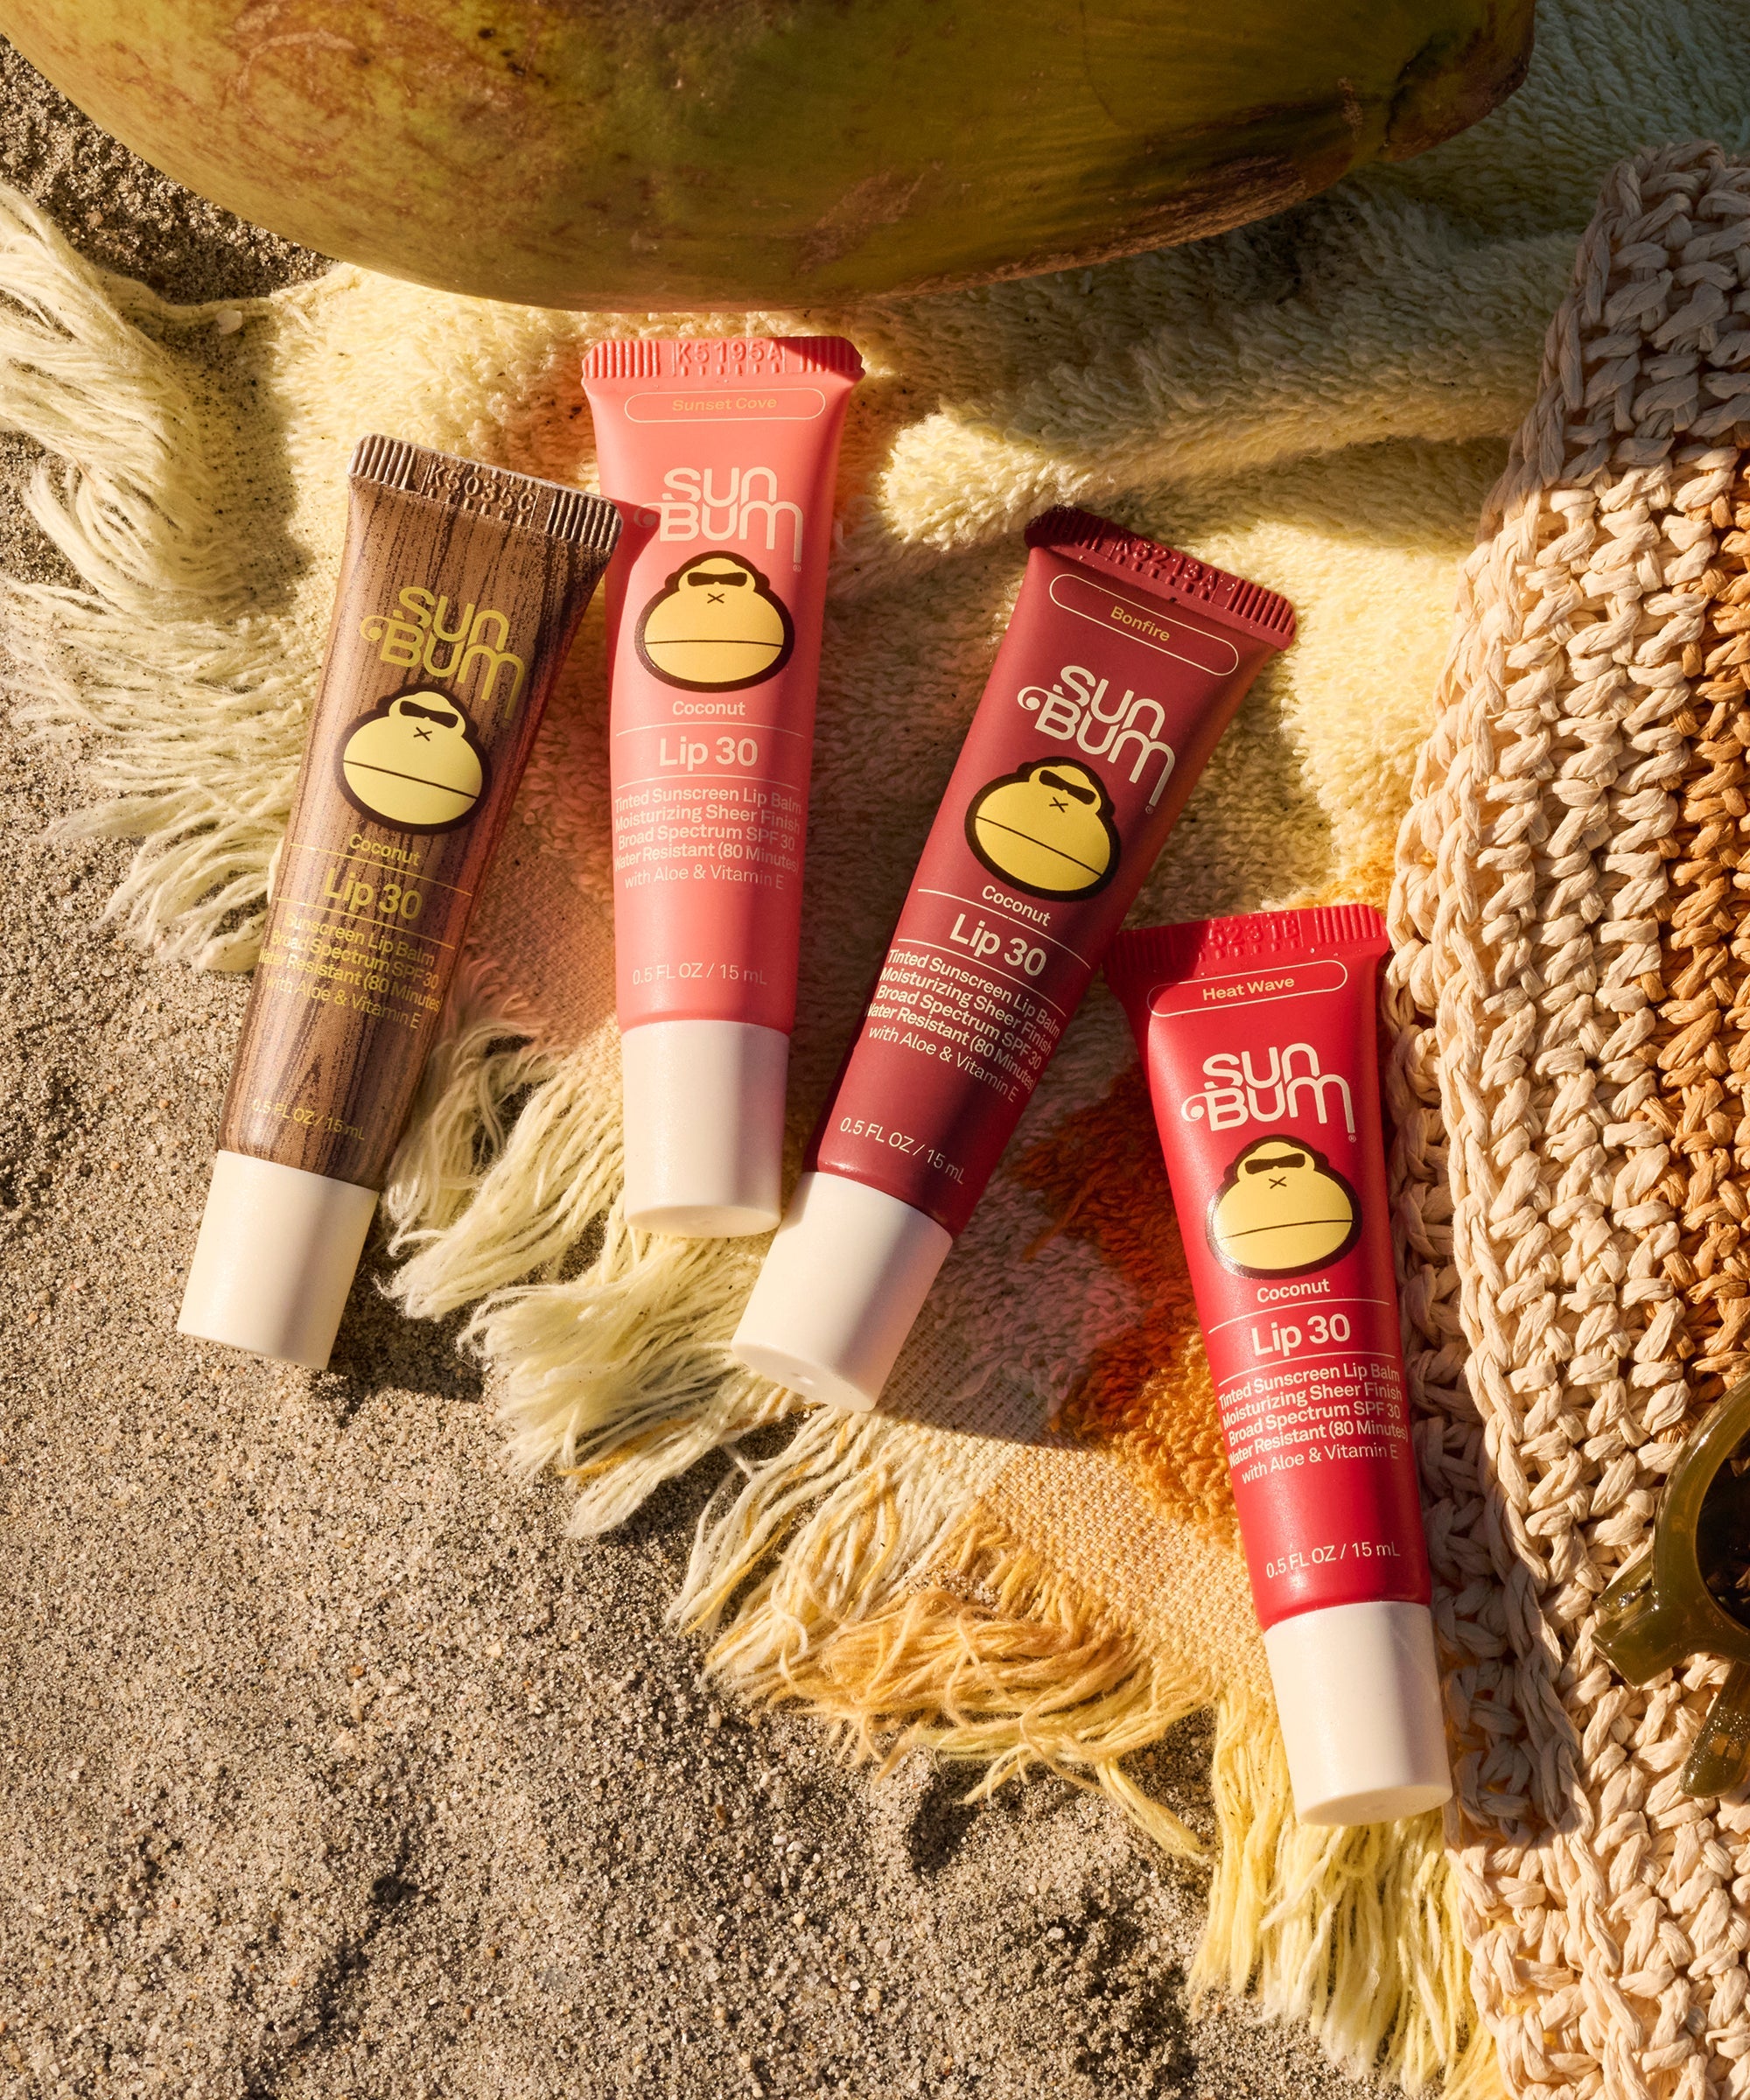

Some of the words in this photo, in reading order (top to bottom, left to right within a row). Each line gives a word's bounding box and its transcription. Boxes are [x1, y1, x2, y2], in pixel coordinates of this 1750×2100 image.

[676, 340, 783, 364] K5195A
[672, 399, 732, 411] Sunset
[736, 397, 778, 410] Cove
[662, 466, 778, 508] SUN
[634, 500, 803, 564] BUM
[1110, 606, 1170, 642] Bonfire
[672, 700, 746, 716] Coconut
[1052, 665, 1166, 739] SUN
[659, 736, 709, 772] Lip
[715, 737, 759, 766] 30
[1017, 686, 1176, 807] BUM
[614, 788, 649, 814] Tinted
[652, 788, 739, 803] Sunscreen
[743, 788, 766, 808] Lip
[771, 792, 802, 815] Balm
[615, 805, 703, 833] Moisturizing
[705, 803, 758, 822] Sheer
[761, 809, 800, 836] Finish
[349, 834, 420, 867] Coconut
[614, 851, 641, 872] Water
[642, 843, 715, 862] Resistant
[718, 841, 743, 860] (80
[619, 826, 654, 850] Broad
[657, 824, 742, 842] Spectrum
[746, 826, 779, 845] SPF
[780, 834, 794, 851] 30
[322, 868, 374, 911] Lip
[379, 883, 423, 920] 30
[625, 869, 651, 889] with
[654, 865, 689, 883] Aloe
[693, 864, 706, 879] &
[710, 864, 772, 886] Vitamin
[775, 874, 784, 890] E
[982, 885, 1051, 927] Coconut
[270, 929, 310, 951] Broad
[310, 938, 389, 973] Spectrum
[391, 962, 425, 982] SPF
[423, 971, 440, 990] 30
[285, 912, 365, 945] Sunscreen
[368, 933, 394, 956] Lip
[396, 941, 435, 967] Balm
[949, 914, 1001, 957] Lip
[1004, 937, 1046, 977] 30
[286, 953, 362, 985] Resistant
[363, 972, 389, 993] (80
[633, 965, 653, 985] 0.5
[656, 963, 676, 981] FL
[679, 962, 703, 979] OZ
[706, 963, 715, 978] /
[719, 964, 739, 981] 15
[744, 968, 767, 985] mL
[887, 949, 930, 969] Tinted
[929, 957, 1012, 1004] Sunscreen
[1013, 994, 1035, 1018] Lip
[1036, 1008, 1060, 1039] Balm
[1202, 984, 1243, 1001] Heat
[1248, 976, 1295, 995] Wave
[295, 980, 331, 1001] Aloe
[334, 989, 348, 1005] &
[352, 993, 409, 1025] Vitamin
[410, 1012, 422, 1029] E
[879, 967, 973, 1008] Moisturizing
[974, 996, 1022, 1029] Sheer
[1021, 1022, 1053, 1056] Finish
[876, 984, 920, 1005] Broad
[920, 994, 1000, 1040] Spectrum
[1002, 1032, 1032, 1057] SPF
[1028, 1051, 1042, 1069] 30
[896, 1006, 970, 1046] Resistant
[970, 1034, 994, 1058] (80
[869, 1025, 899, 1043] with
[900, 1032, 936, 1055] Aloe
[939, 1045, 953, 1063] &
[956, 1052, 1009, 1095] Vitamin
[1008, 1086, 1019, 1102] E
[1202, 1043, 1320, 1089] SUN
[274, 1102, 290, 1119] FL
[293, 1107, 315, 1125] OZ
[326, 1117, 343, 1133] 15
[345, 1126, 365, 1140] mL
[1181, 1074, 1355, 1133] BUM
[840, 1116, 864, 1135] 0.5
[864, 1124, 885, 1142] FL
[888, 1132, 914, 1153] OZ
[913, 1144, 925, 1156] /
[927, 1149, 943, 1169] 15
[946, 1164, 964, 1185] mL
[1256, 1278, 1330, 1303] Coconut
[1251, 1322, 1302, 1356] Lip
[1307, 1313, 1351, 1344] 30
[1218, 1382, 1252, 1410] Tinted
[1254, 1366, 1340, 1393] Sunscreen
[1343, 1362, 1368, 1381] Lip
[1370, 1363, 1400, 1382] Balm
[1222, 1390, 1308, 1431] Moisturizing
[1310, 1383, 1361, 1402] Sheer
[1364, 1382, 1403, 1401] Finish
[1228, 1418, 1263, 1447] Broad
[1265, 1404, 1350, 1431] Spectrum
[1354, 1400, 1384, 1416] SPF
[1387, 1403, 1401, 1419] 30
[1228, 1445, 1253, 1469] Water
[1255, 1424, 1326, 1454] Resistant
[1329, 1420, 1354, 1439] (80
[1356, 1419, 1408, 1442] Minutes)
[1242, 1461, 1267, 1484] with
[1270, 1453, 1304, 1473] Aloe
[1309, 1447, 1322, 1463] &
[1324, 1442, 1387, 1460] Vitamin
[1390, 1444, 1399, 1460] E
[1266, 1558, 1287, 1578] 0.5
[1290, 1552, 1309, 1572] FL
[1312, 1545, 1336, 1564] OZ
[1340, 1544, 1347, 1559] /
[1352, 1542, 1371, 1558] 15
[1376, 1541, 1400, 1558] mL
